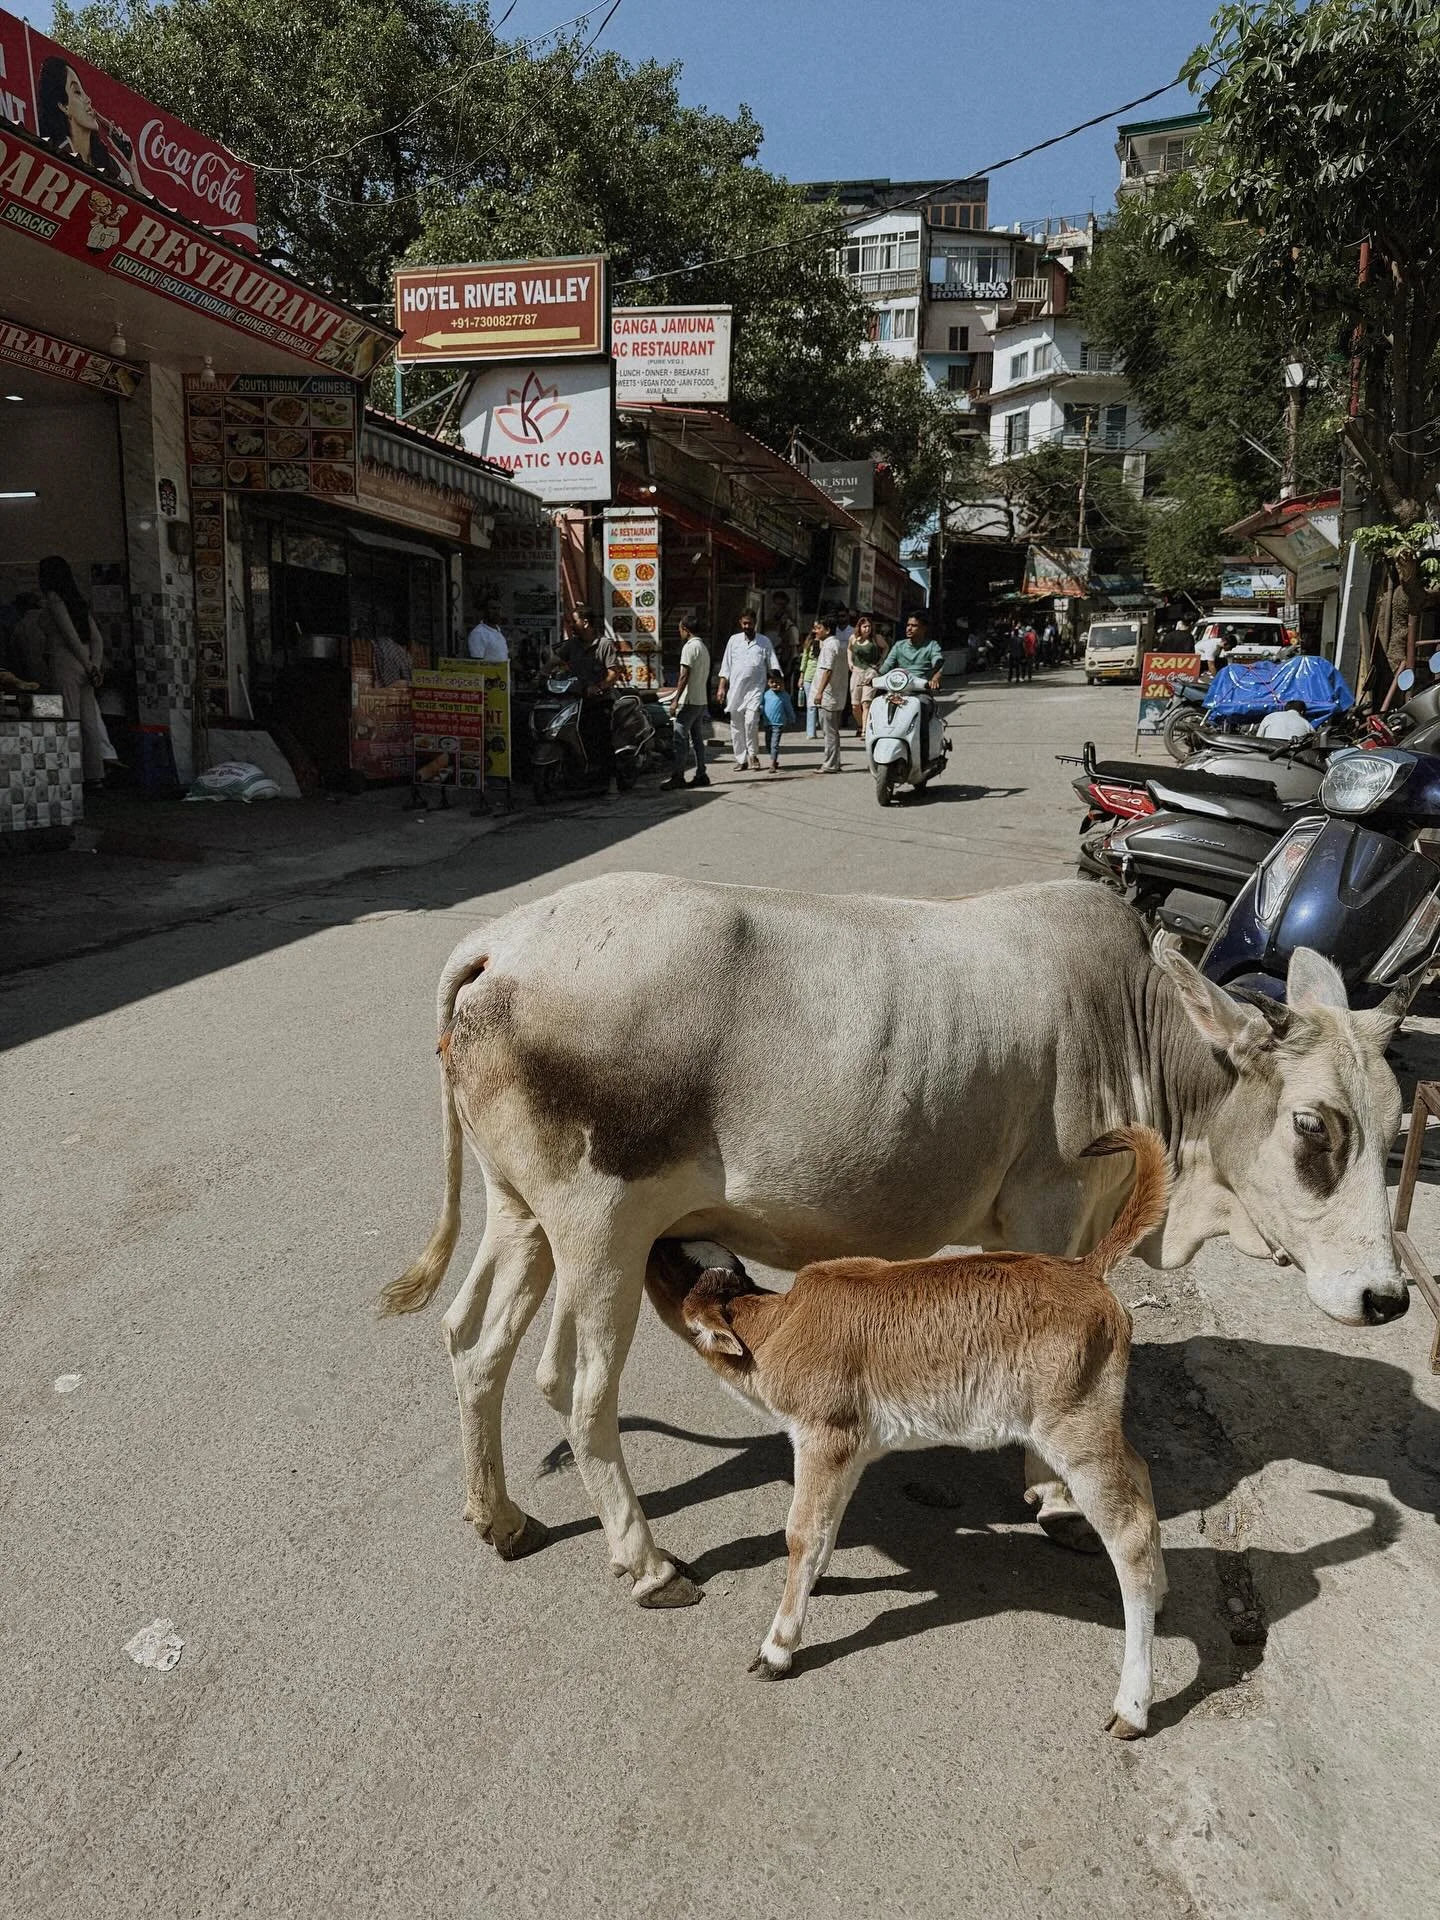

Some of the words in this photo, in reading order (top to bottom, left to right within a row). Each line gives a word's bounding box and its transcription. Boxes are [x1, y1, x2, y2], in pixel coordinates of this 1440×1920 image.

[138, 118, 244, 217] Coca-Cola
[5, 202, 57, 238] SNACKS
[0, 139, 92, 220] ARI
[121, 214, 343, 341] RESTAURANT
[114, 256, 158, 284] INDIAN
[403, 286, 460, 312] HOTEL
[464, 281, 518, 308] RIVER
[521, 276, 591, 304] VALLEY
[931, 282, 1009, 291] KRISHNA
[160, 276, 197, 302] SOUTH
[197, 294, 235, 319] INDIAN
[931, 291, 972, 299] HOME
[235, 311, 277, 338] CHINESE
[450, 313, 538, 329] +91-7300827787
[613, 319, 658, 335] GANGA
[661, 317, 715, 334] JAMUNA
[276, 331, 315, 354] BANGALI
[611, 342, 628, 357] AC
[632, 340, 715, 357] RESTAURANT
[620, 369, 641, 377] LUNCH
[645, 369, 669, 377] DINNER
[674, 368, 710, 377] BREAKFAST
[189, 377, 227, 391] INDIAN
[239, 379, 267, 392] SOUTH
[270, 379, 299, 392] INDIAN
[311, 380, 351, 393] CHINESE
[641, 379, 659, 387] VEGAN
[557, 450, 604, 466] YOGA
[619, 527, 655, 537] RESTAURANT
[1150, 656, 1197, 670] RAVI
[1146, 671, 1166, 681] Hair
